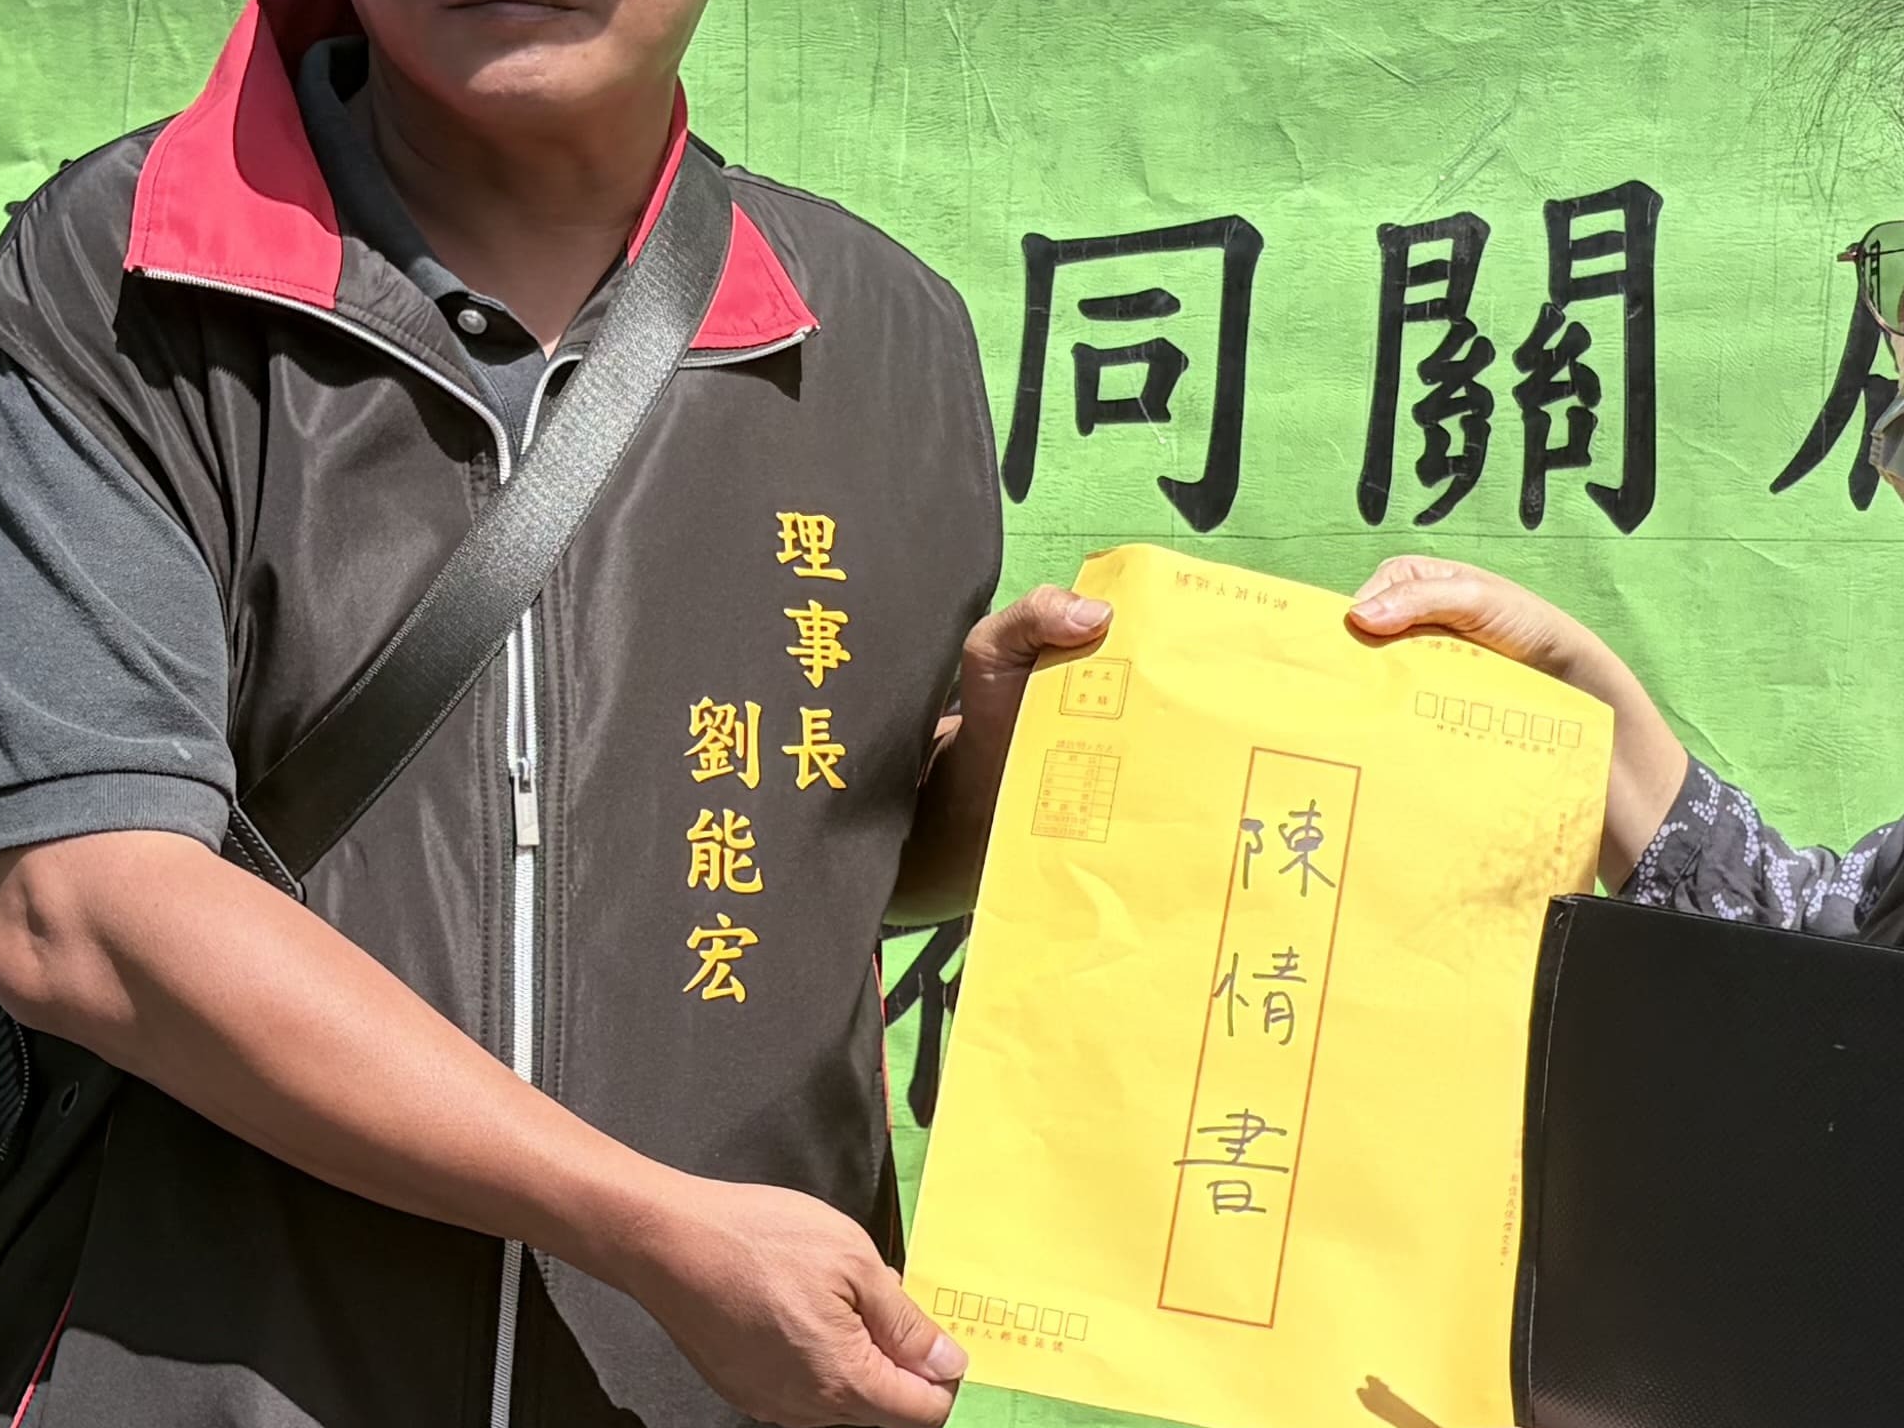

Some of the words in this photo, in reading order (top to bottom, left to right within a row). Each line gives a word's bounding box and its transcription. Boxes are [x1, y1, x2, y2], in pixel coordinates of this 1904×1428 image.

[774, 509, 852, 792] 理事長
[682, 694, 762, 1005] 劉能宏
[1174, 798, 1338, 1215] 陳情書
